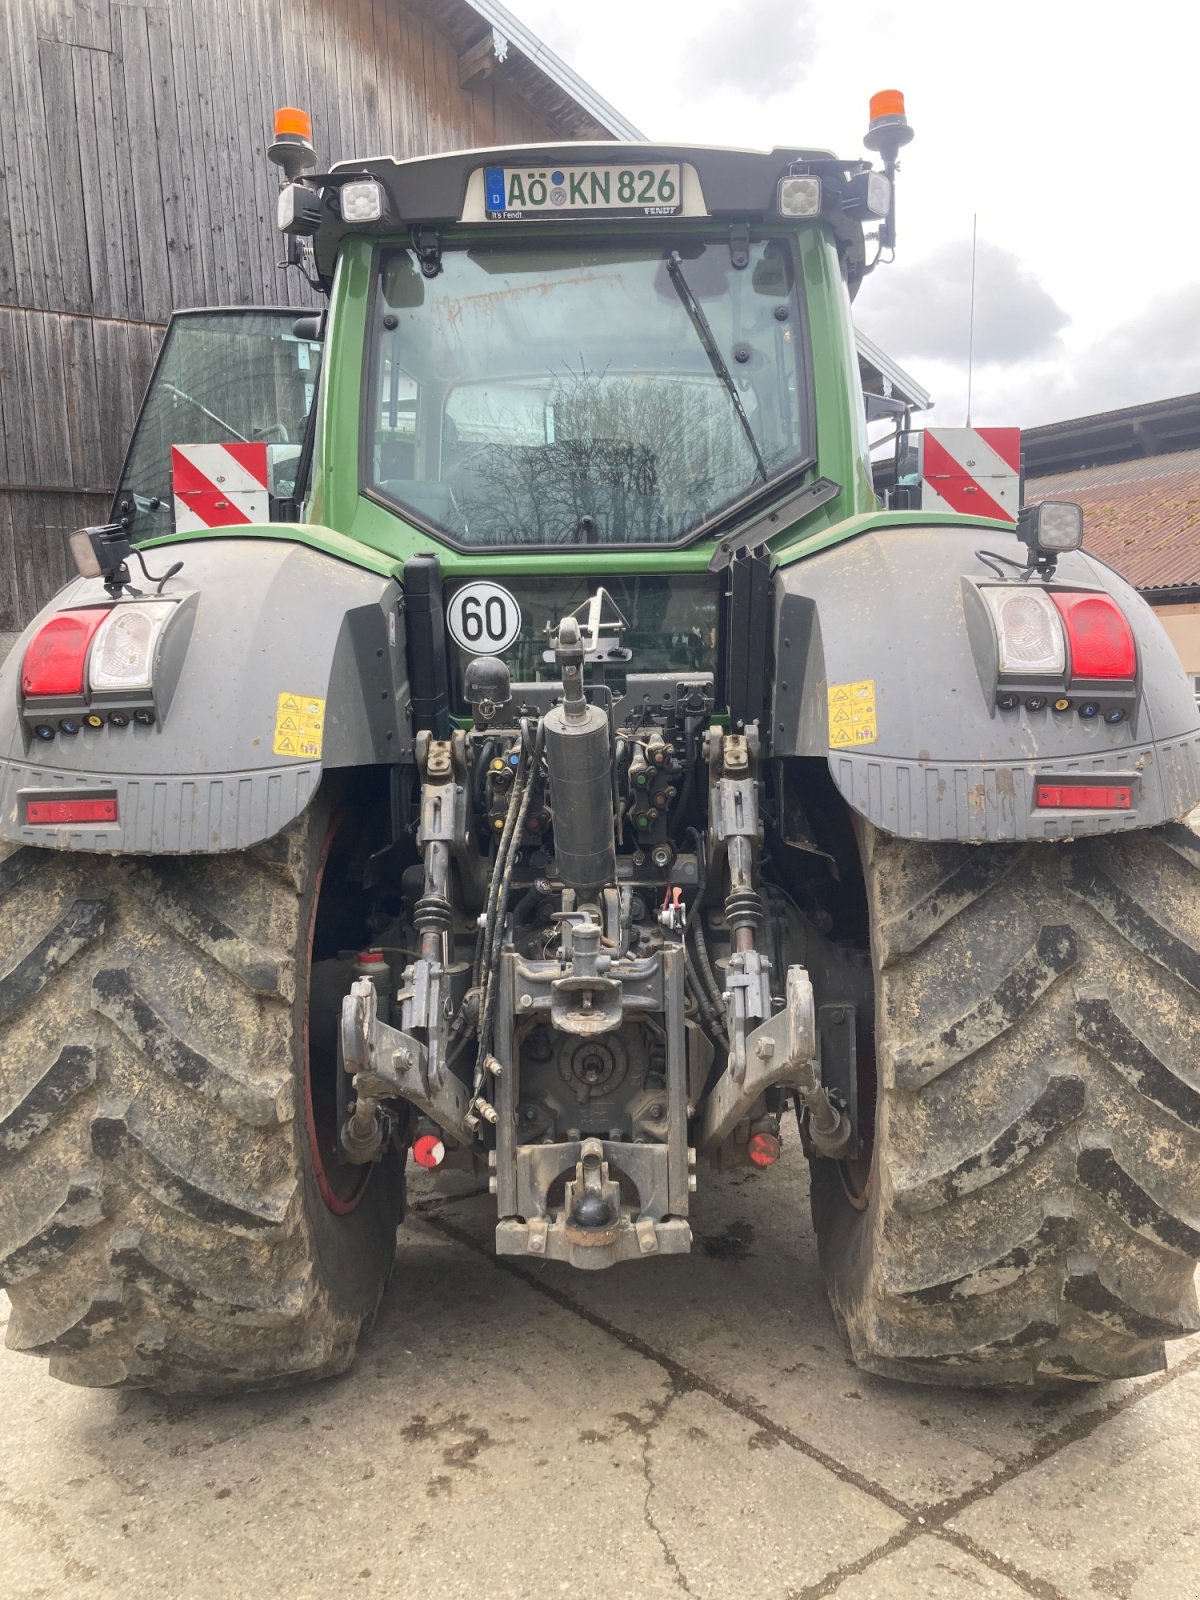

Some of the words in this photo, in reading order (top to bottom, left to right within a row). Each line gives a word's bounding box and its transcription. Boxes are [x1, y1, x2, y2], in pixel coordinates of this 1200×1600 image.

[507, 173, 547, 206] AÖ
[569, 171, 610, 204] KN
[617, 170, 675, 203] 826
[492, 194, 500, 204] D
[491, 211, 502, 219] It's
[644, 206, 676, 215] FENDT
[461, 596, 507, 641] 60
